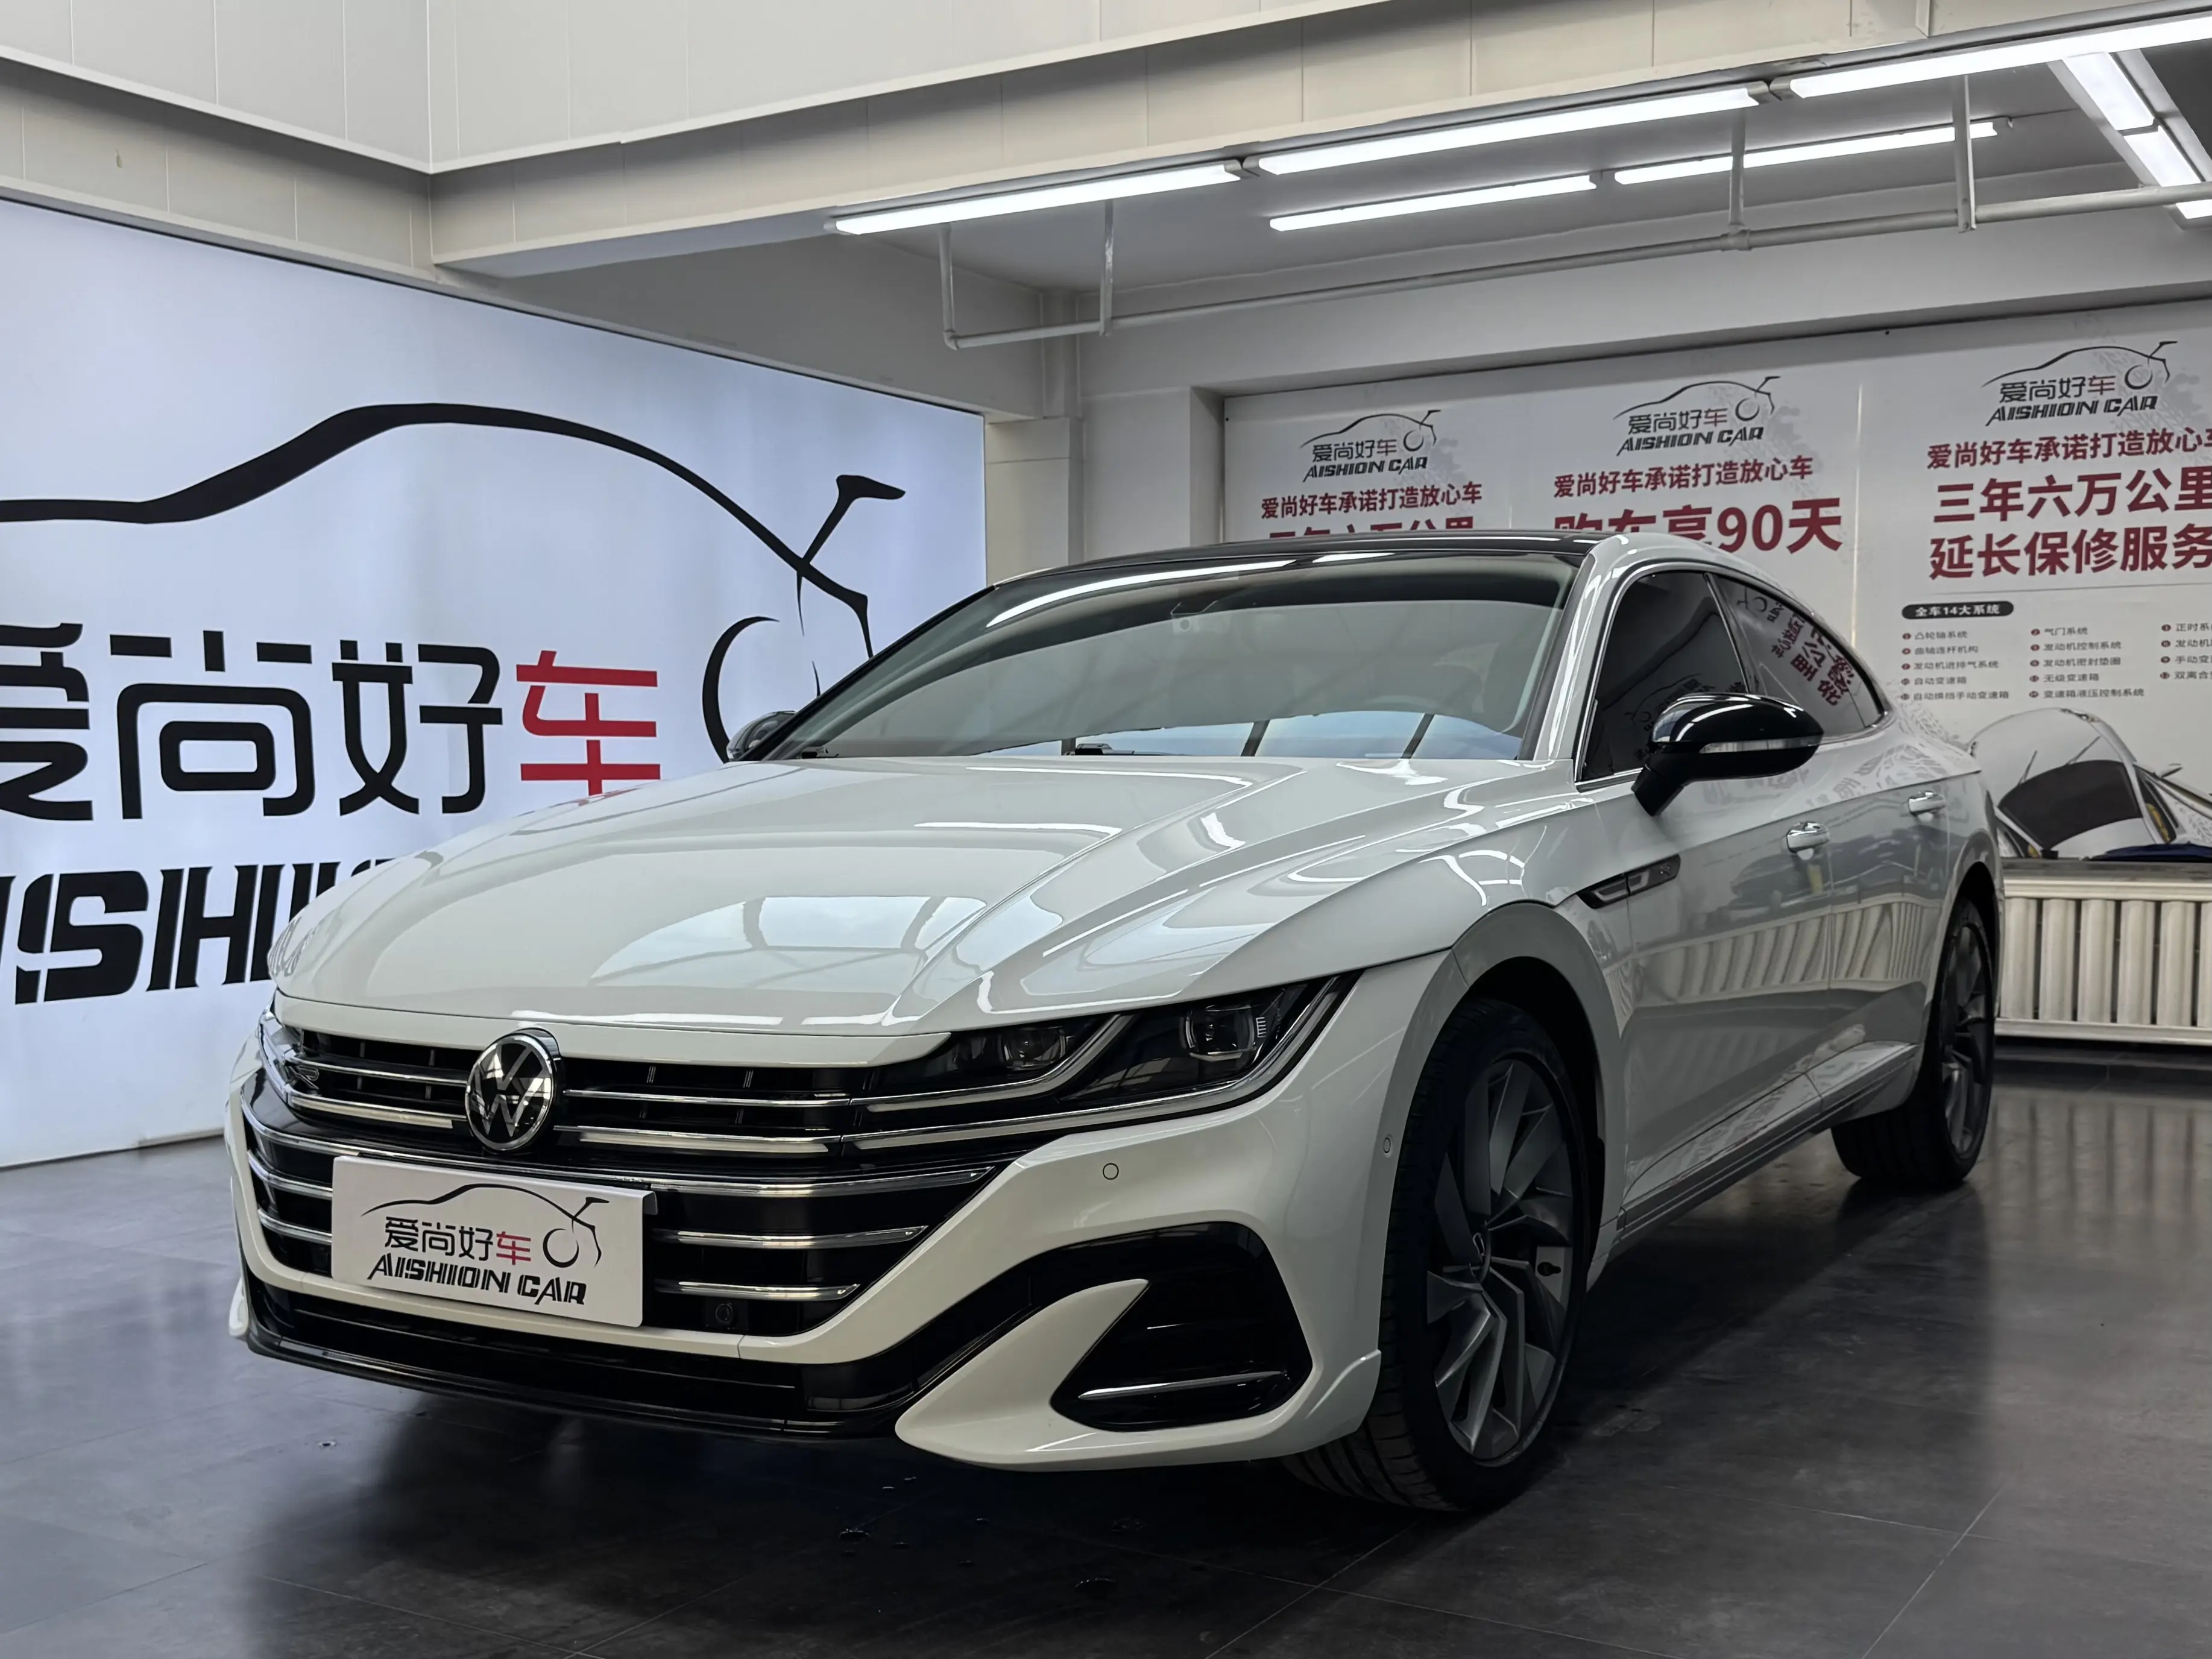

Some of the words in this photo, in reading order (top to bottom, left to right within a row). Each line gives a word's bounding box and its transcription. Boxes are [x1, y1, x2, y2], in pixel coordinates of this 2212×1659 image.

[1999, 375, 2116, 403] 爱尚好车
[1628, 408, 1727, 435] 爱尚好车
[1985, 400, 2097, 426] AISHION
[2103, 396, 2158, 416] CAR
[1312, 439, 1396, 462] 爱尚好车
[1617, 432, 1712, 456] AISHION
[1717, 426, 1763, 446] CAR
[1303, 460, 1384, 482] AISHION
[1388, 456, 1428, 474] CAR
[1554, 455, 1813, 497] 爱尚好车承诺打造放心车
[1261, 481, 1482, 518] 爱尚好车承诺打造放心车
[1933, 466, 2212, 522] 三年六万公里
[1930, 523, 2212, 580] 延长保修服务
[1915, 604, 2000, 617] 全车14大系统
[2176, 622, 2212, 631] 正时系
[2175, 639, 2212, 647] 发动机
[2175, 655, 2212, 664] 手动变
[2174, 670, 2212, 679] 双离合
[384, 1217, 531, 1265] 爱尚好车
[367, 1253, 511, 1294] AISHION
[517, 1274, 587, 1305] CAR
